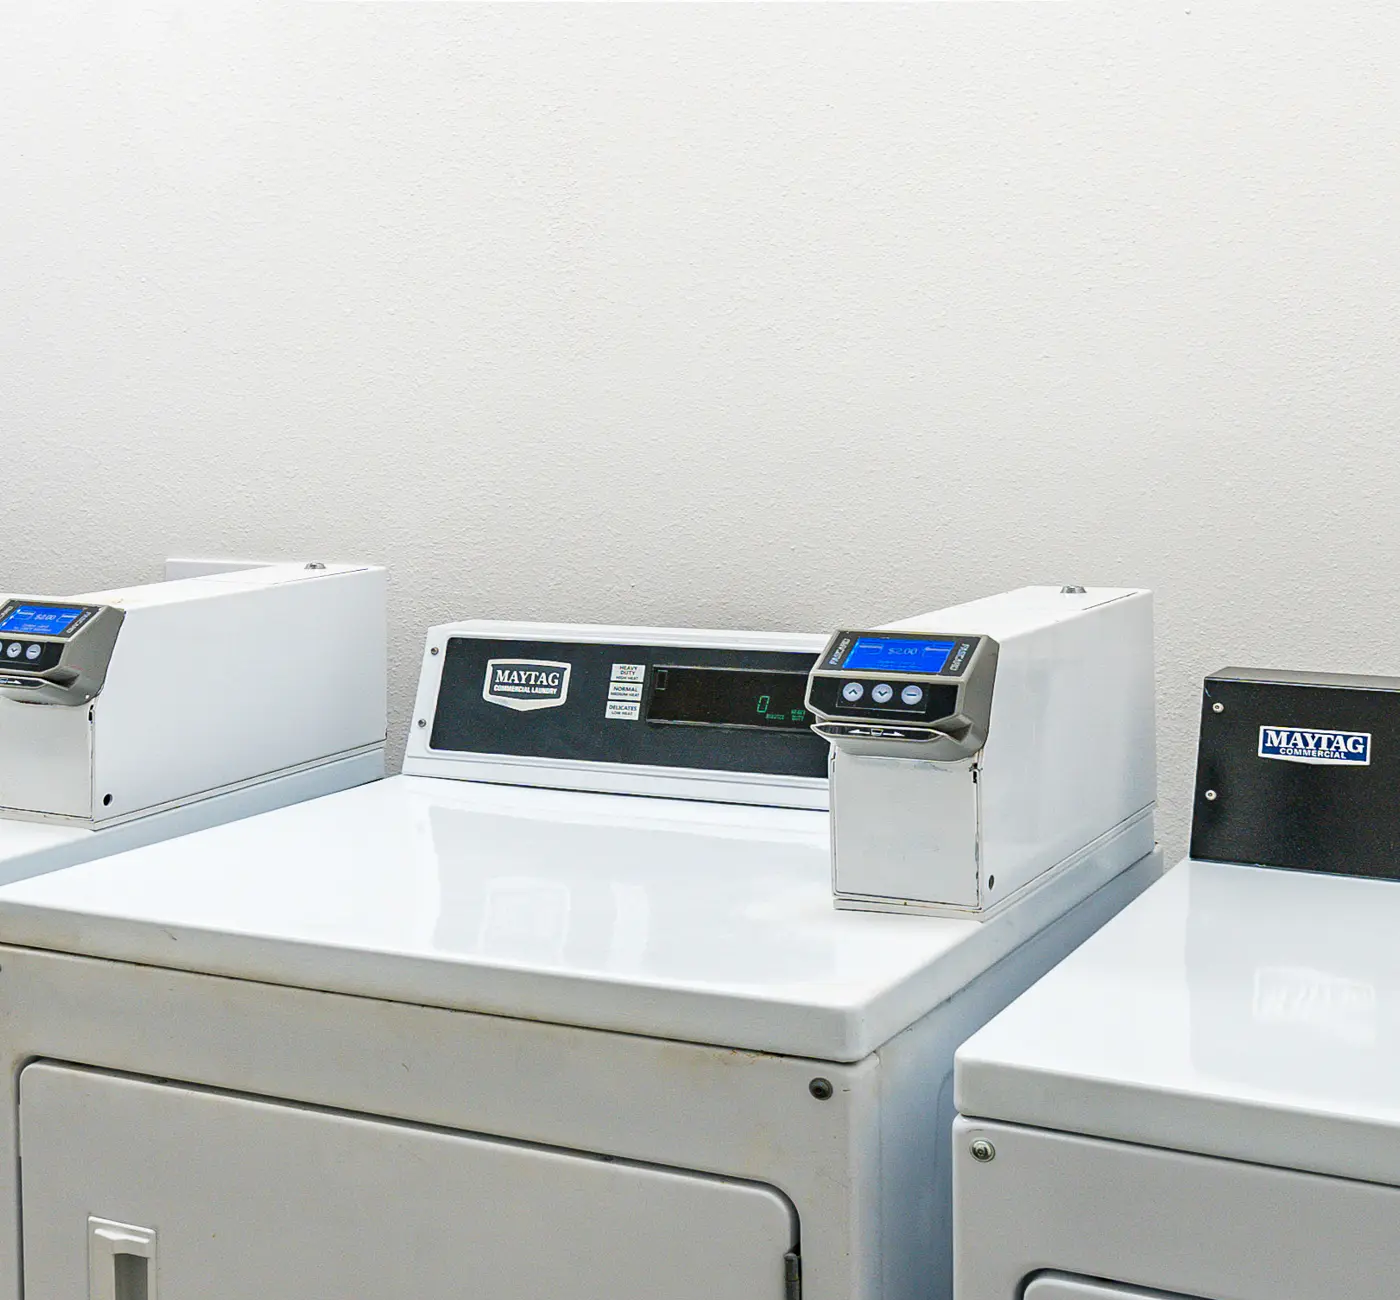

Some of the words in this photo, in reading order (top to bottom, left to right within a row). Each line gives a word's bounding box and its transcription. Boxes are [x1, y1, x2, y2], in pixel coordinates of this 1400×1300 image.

[828, 637, 851, 665] FASCARD
[949, 643, 971, 671] FASCARD
[494, 669, 560, 686] MAYTAG
[493, 684, 531, 694] COMMERCIAL
[532, 686, 558, 695] LAUNDRY
[1264, 730, 1365, 754] MAYTAG
[1279, 747, 1347, 760] COMMERCIAL
